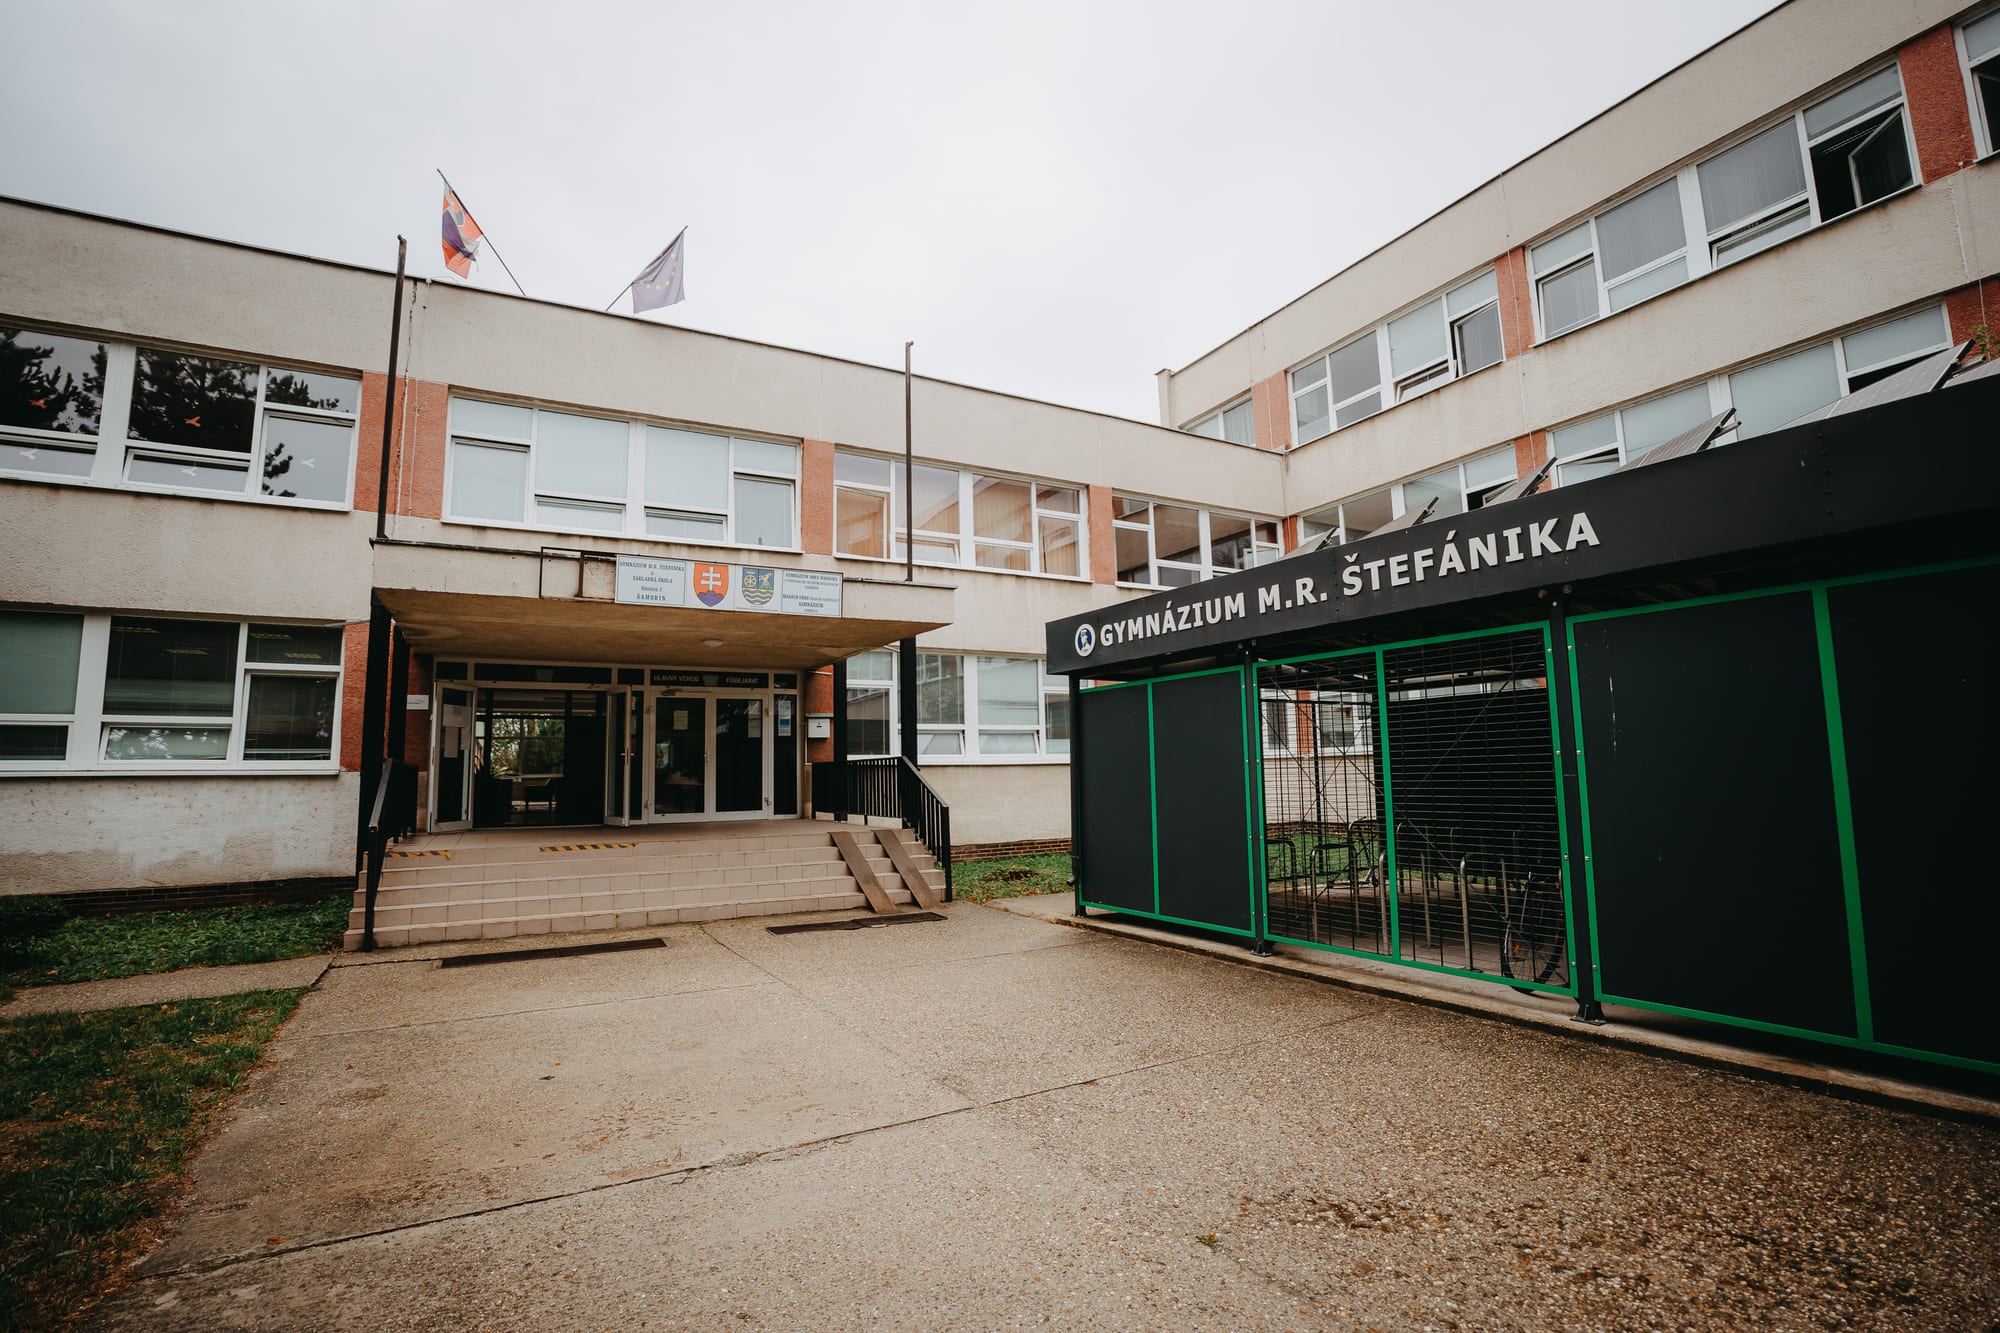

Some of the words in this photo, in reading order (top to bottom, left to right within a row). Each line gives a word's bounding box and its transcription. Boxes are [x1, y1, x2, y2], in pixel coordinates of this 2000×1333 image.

[1100, 592, 1246, 647] GYMNÁZIUM
[1257, 577, 1328, 614] M.R.
[1342, 512, 1600, 597] ŠTEFÁNIKA
